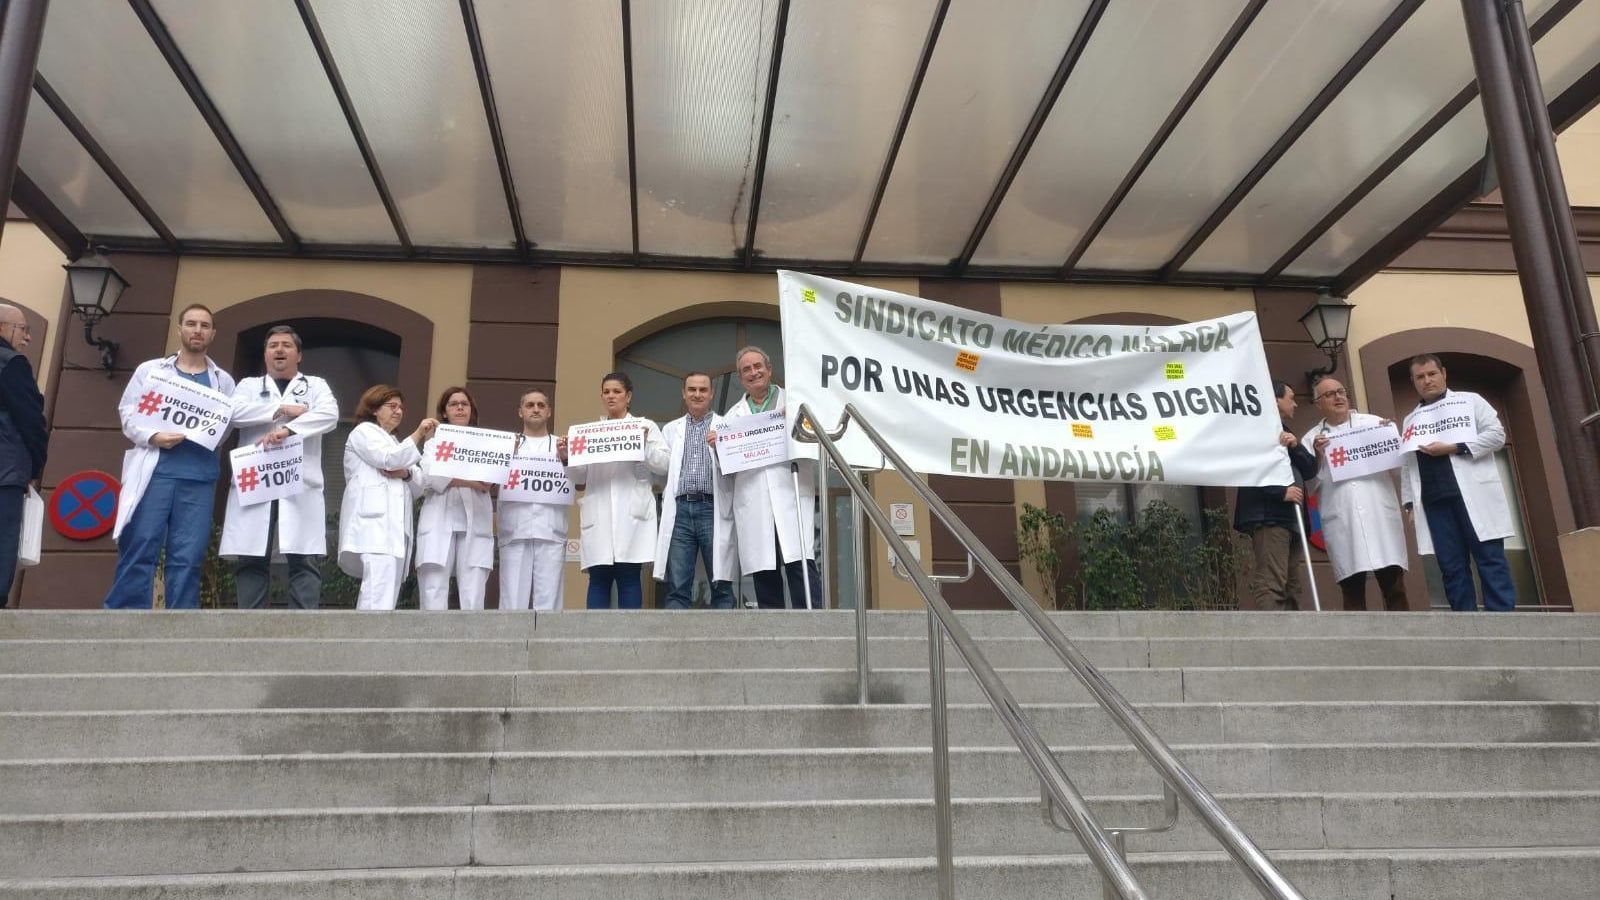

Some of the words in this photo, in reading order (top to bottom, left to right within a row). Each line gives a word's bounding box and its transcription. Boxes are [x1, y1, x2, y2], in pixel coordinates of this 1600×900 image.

[834, 291, 995, 349] SINDICATO
[1002, 326, 1113, 359] MÉDICO
[1121, 321, 1234, 353] MÁLAGA
[821, 354, 884, 393] POR
[892, 365, 970, 407] UNAS
[975, 385, 1148, 421] URGENCIAS
[1152, 382, 1262, 418] DIGNAS
[161, 406, 217, 437] 100%
[576, 423, 639, 435] URGENCIAS
[1414, 429, 1427, 437] LO
[1429, 421, 1472, 435] URGENTE
[587, 435, 628, 445] FRACASO
[587, 442, 641, 454] GESTIÓN
[452, 453, 466, 462] LO
[467, 456, 511, 468] URGENTE
[951, 437, 990, 474] EN
[999, 443, 1165, 483] ANDALUCÍA
[1346, 453, 1359, 462] LO
[1361, 444, 1401, 460] URGENTE
[260, 466, 300, 489] 100%
[520, 477, 570, 495] 100%
